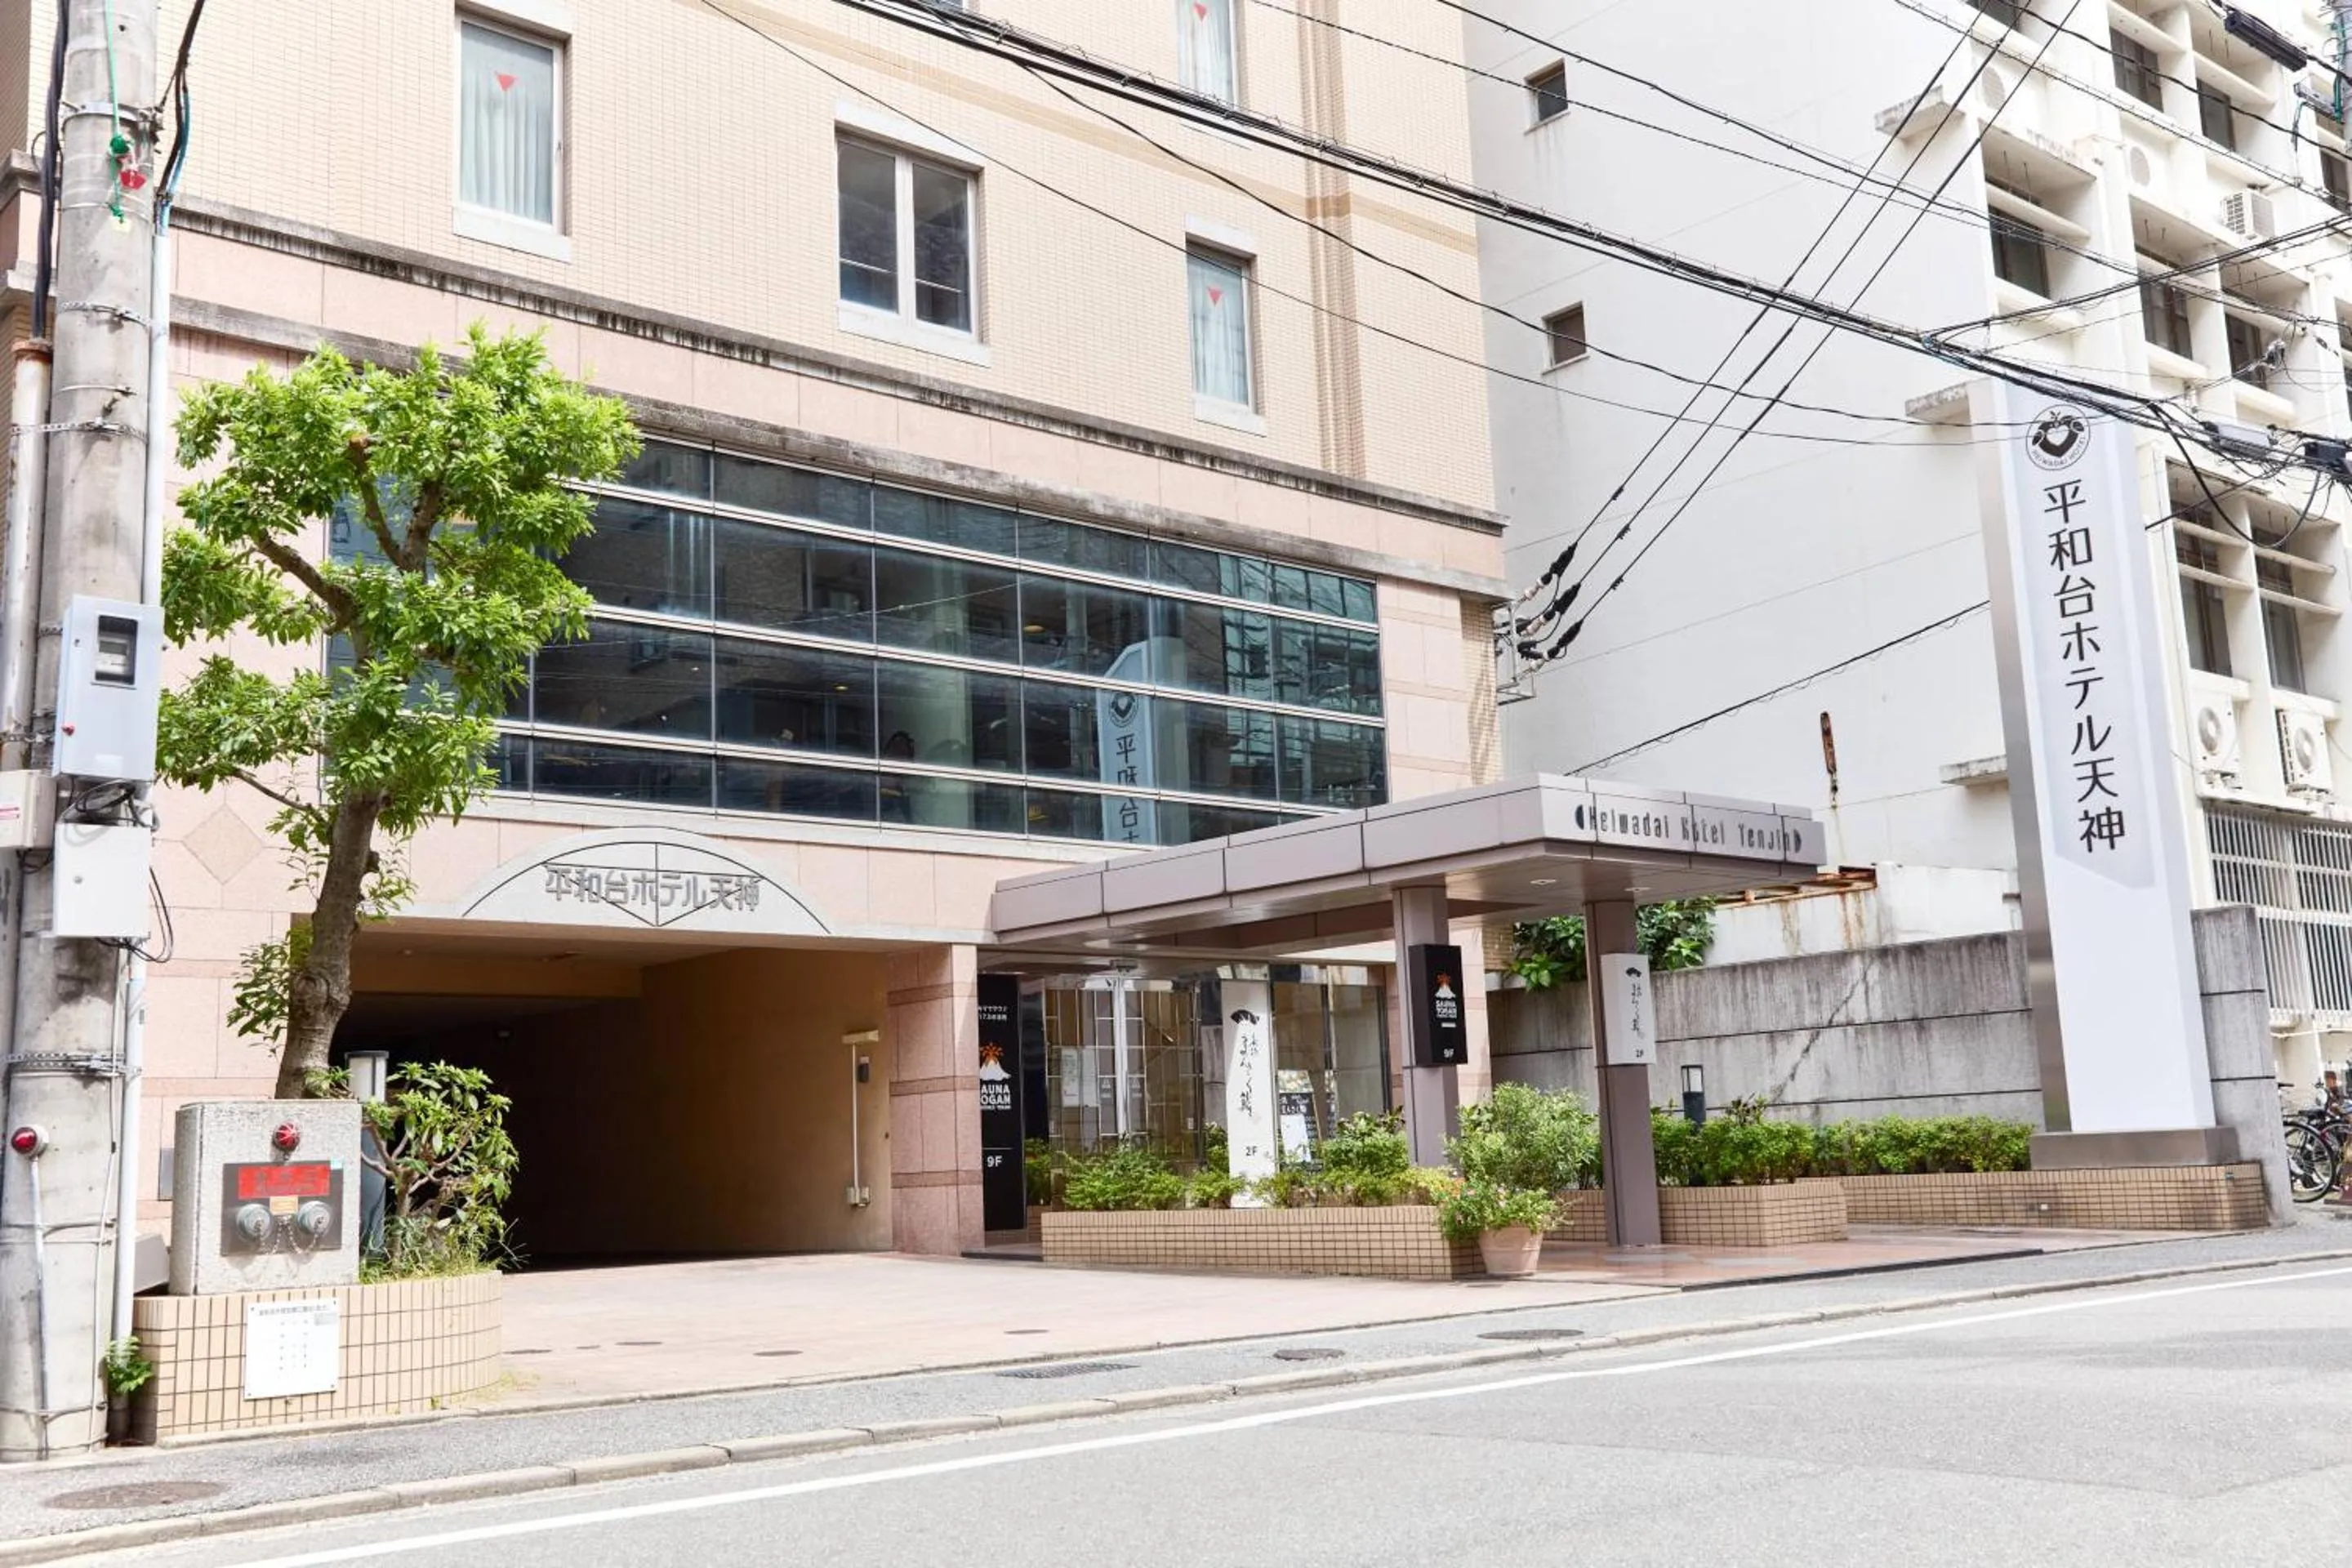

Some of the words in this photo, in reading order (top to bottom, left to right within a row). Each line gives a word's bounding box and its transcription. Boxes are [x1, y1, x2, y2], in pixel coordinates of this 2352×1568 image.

[2043, 479, 2124, 853] 平和台ホテル天神
[1589, 806, 1669, 838] Heiwadai
[1681, 817, 1726, 844] Hotel
[545, 866, 760, 912] 平和台ホテル天神
[980, 1084, 1010, 1094] AUNA
[980, 1094, 1011, 1105] OGAN
[1245, 1146, 1258, 1156] 2F
[987, 1156, 1002, 1167] 9F
